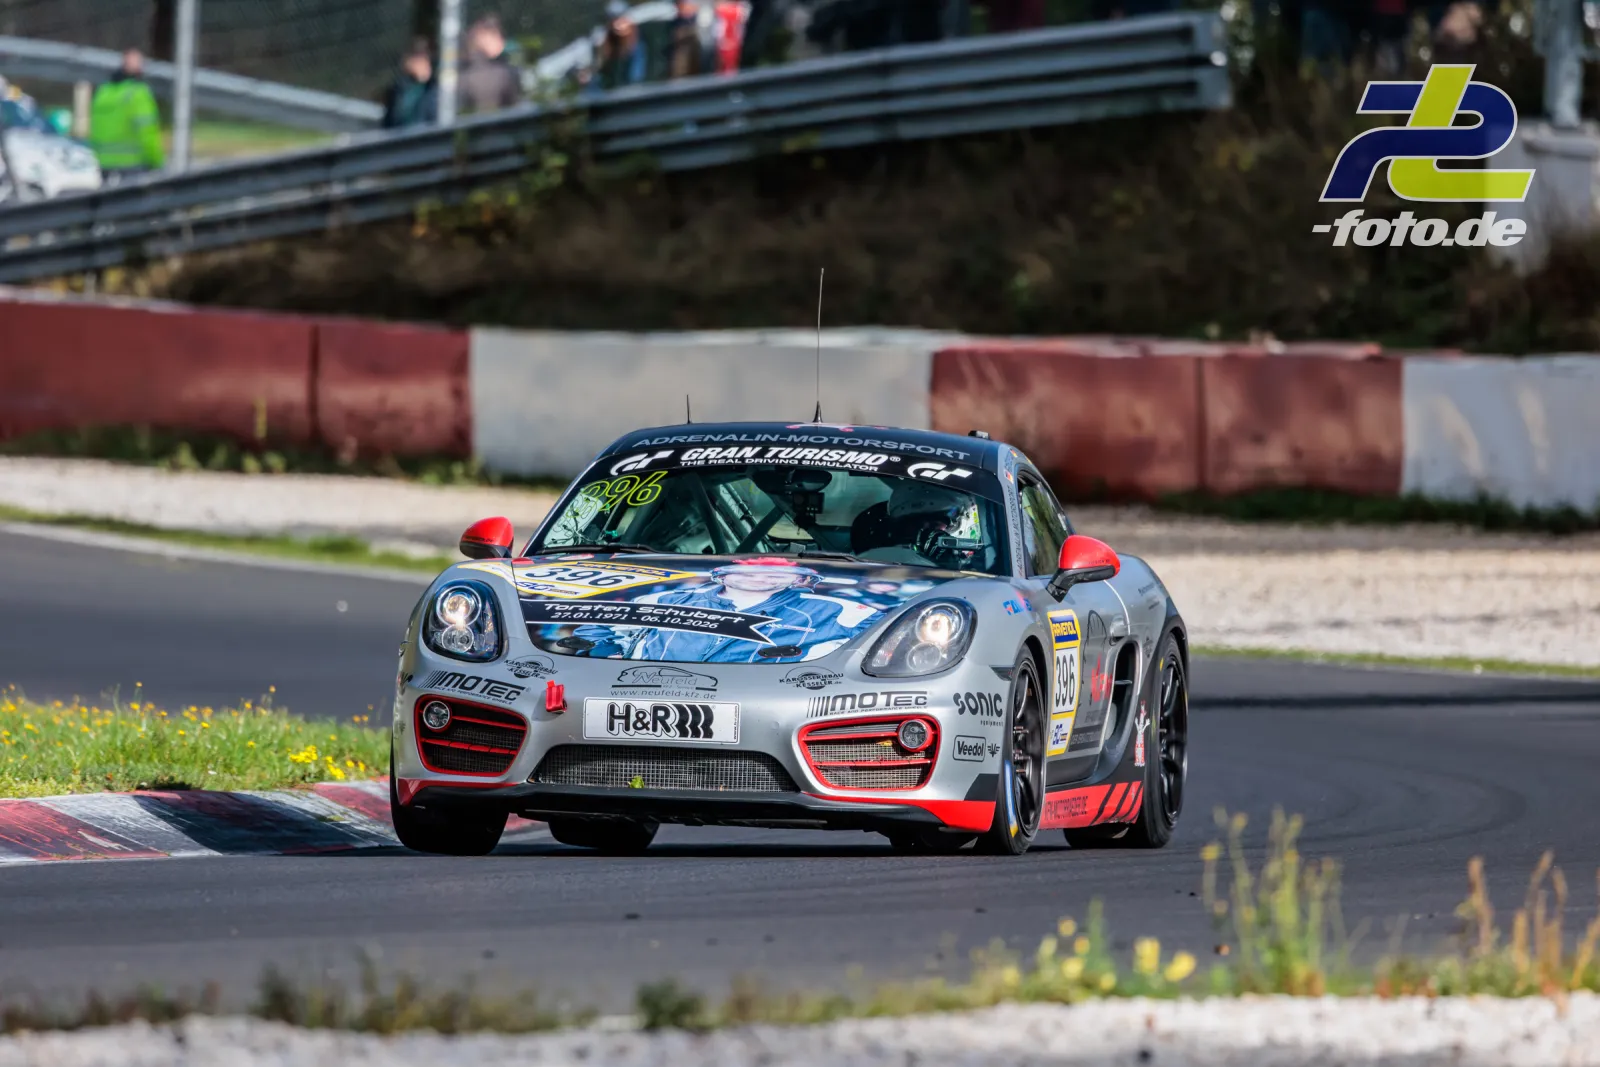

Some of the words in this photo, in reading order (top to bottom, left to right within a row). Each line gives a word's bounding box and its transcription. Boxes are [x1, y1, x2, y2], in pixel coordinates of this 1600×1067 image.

[632, 434, 970, 460] ADRENALIN-MOTORSPORT
[680, 446, 763, 462] GRAN
[744, 457, 799, 465] DRIVING
[801, 459, 879, 473] SIMULATOR
[524, 567, 636, 587] 396
[544, 603, 631, 613] Torsten
[636, 606, 746, 623] Schubert
[640, 615, 720, 629] 06.10.2026
[632, 671, 698, 686] Neufeld
[1055, 653, 1076, 708] 396
[610, 689, 718, 700] www.neufeld-kfz.de
[606, 702, 677, 738] H&R
[957, 740, 985, 757] Veedol
